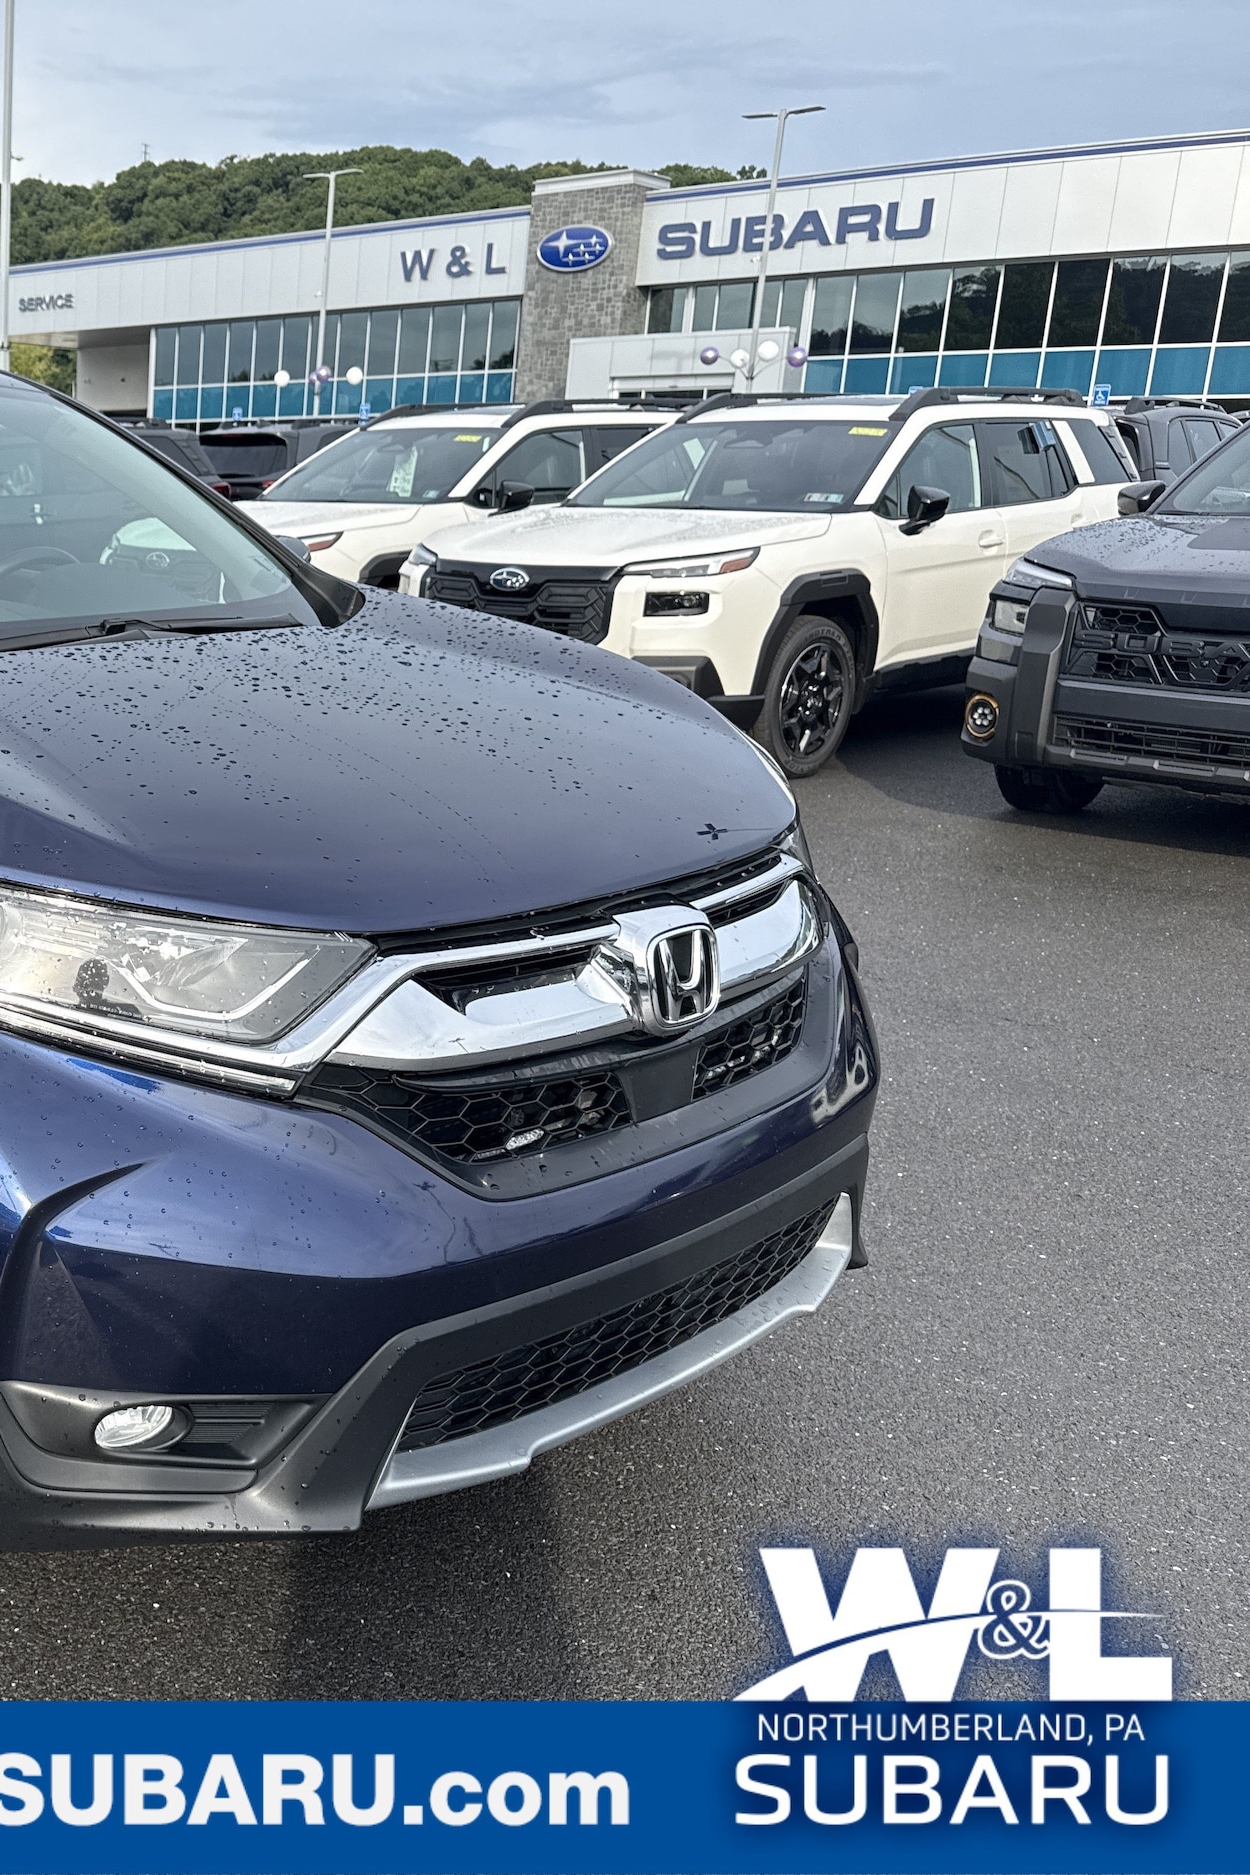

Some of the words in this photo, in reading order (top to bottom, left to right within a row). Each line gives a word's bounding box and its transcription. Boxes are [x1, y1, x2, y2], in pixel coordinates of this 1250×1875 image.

[656, 197, 936, 261] SUBARU
[400, 248, 437, 283] W
[445, 245, 474, 279] &
[485, 242, 507, 275] L
[18, 293, 74, 313] SERVICE
